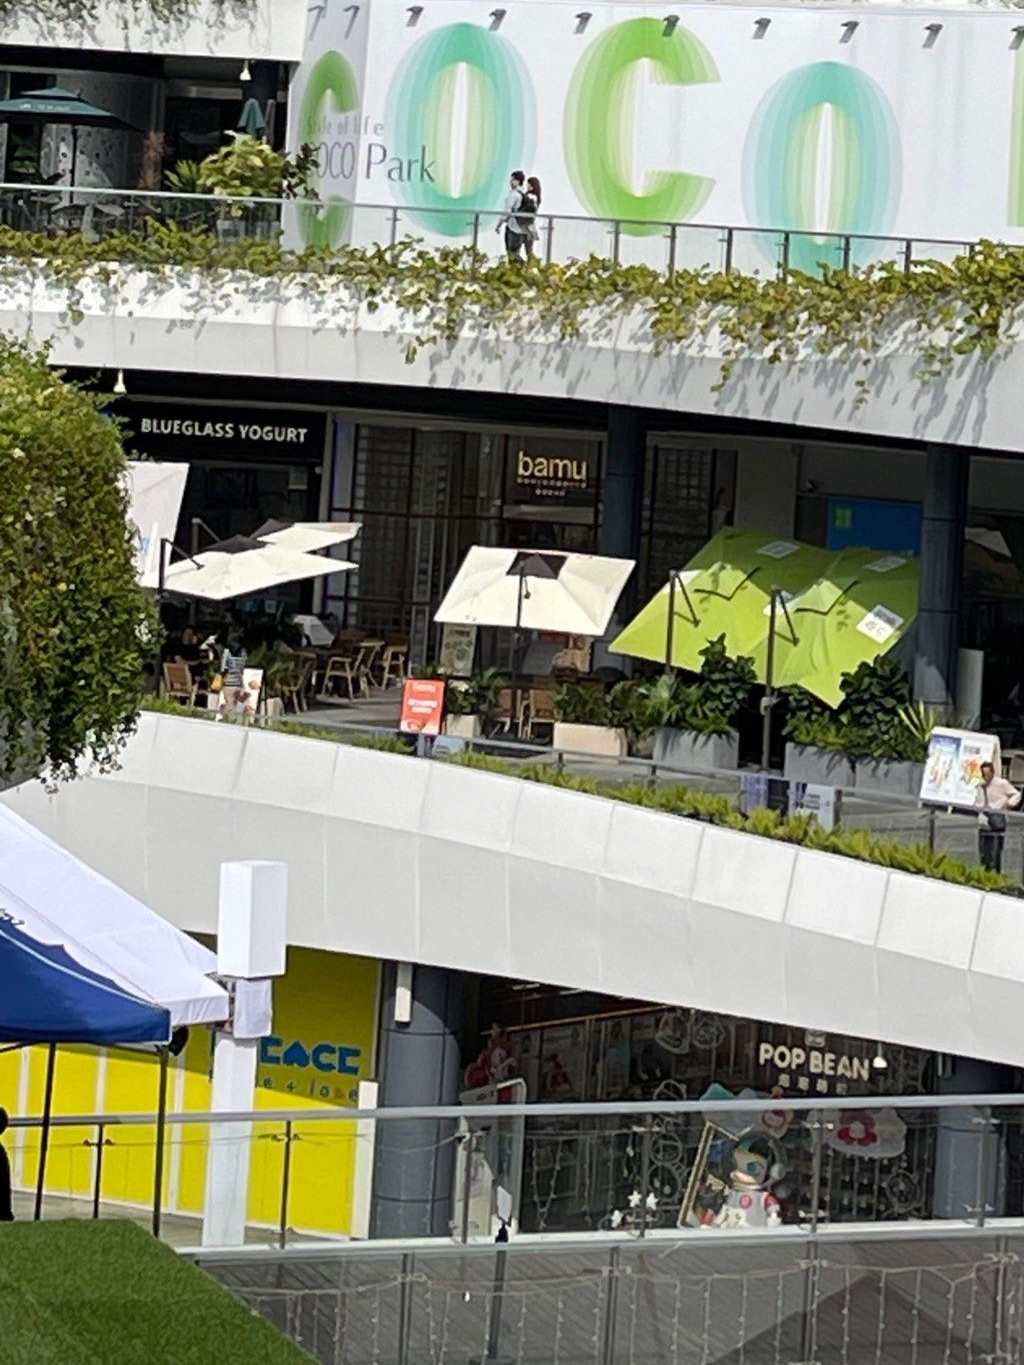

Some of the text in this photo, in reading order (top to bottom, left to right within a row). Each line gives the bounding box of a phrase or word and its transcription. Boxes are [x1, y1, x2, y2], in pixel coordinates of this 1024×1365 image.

[365, 142, 436, 183] Park
[141, 418, 308, 443] BLUEGLASS YOGURT
[517, 450, 587, 481] bamu
[759, 1042, 870, 1082] POP BEAN
